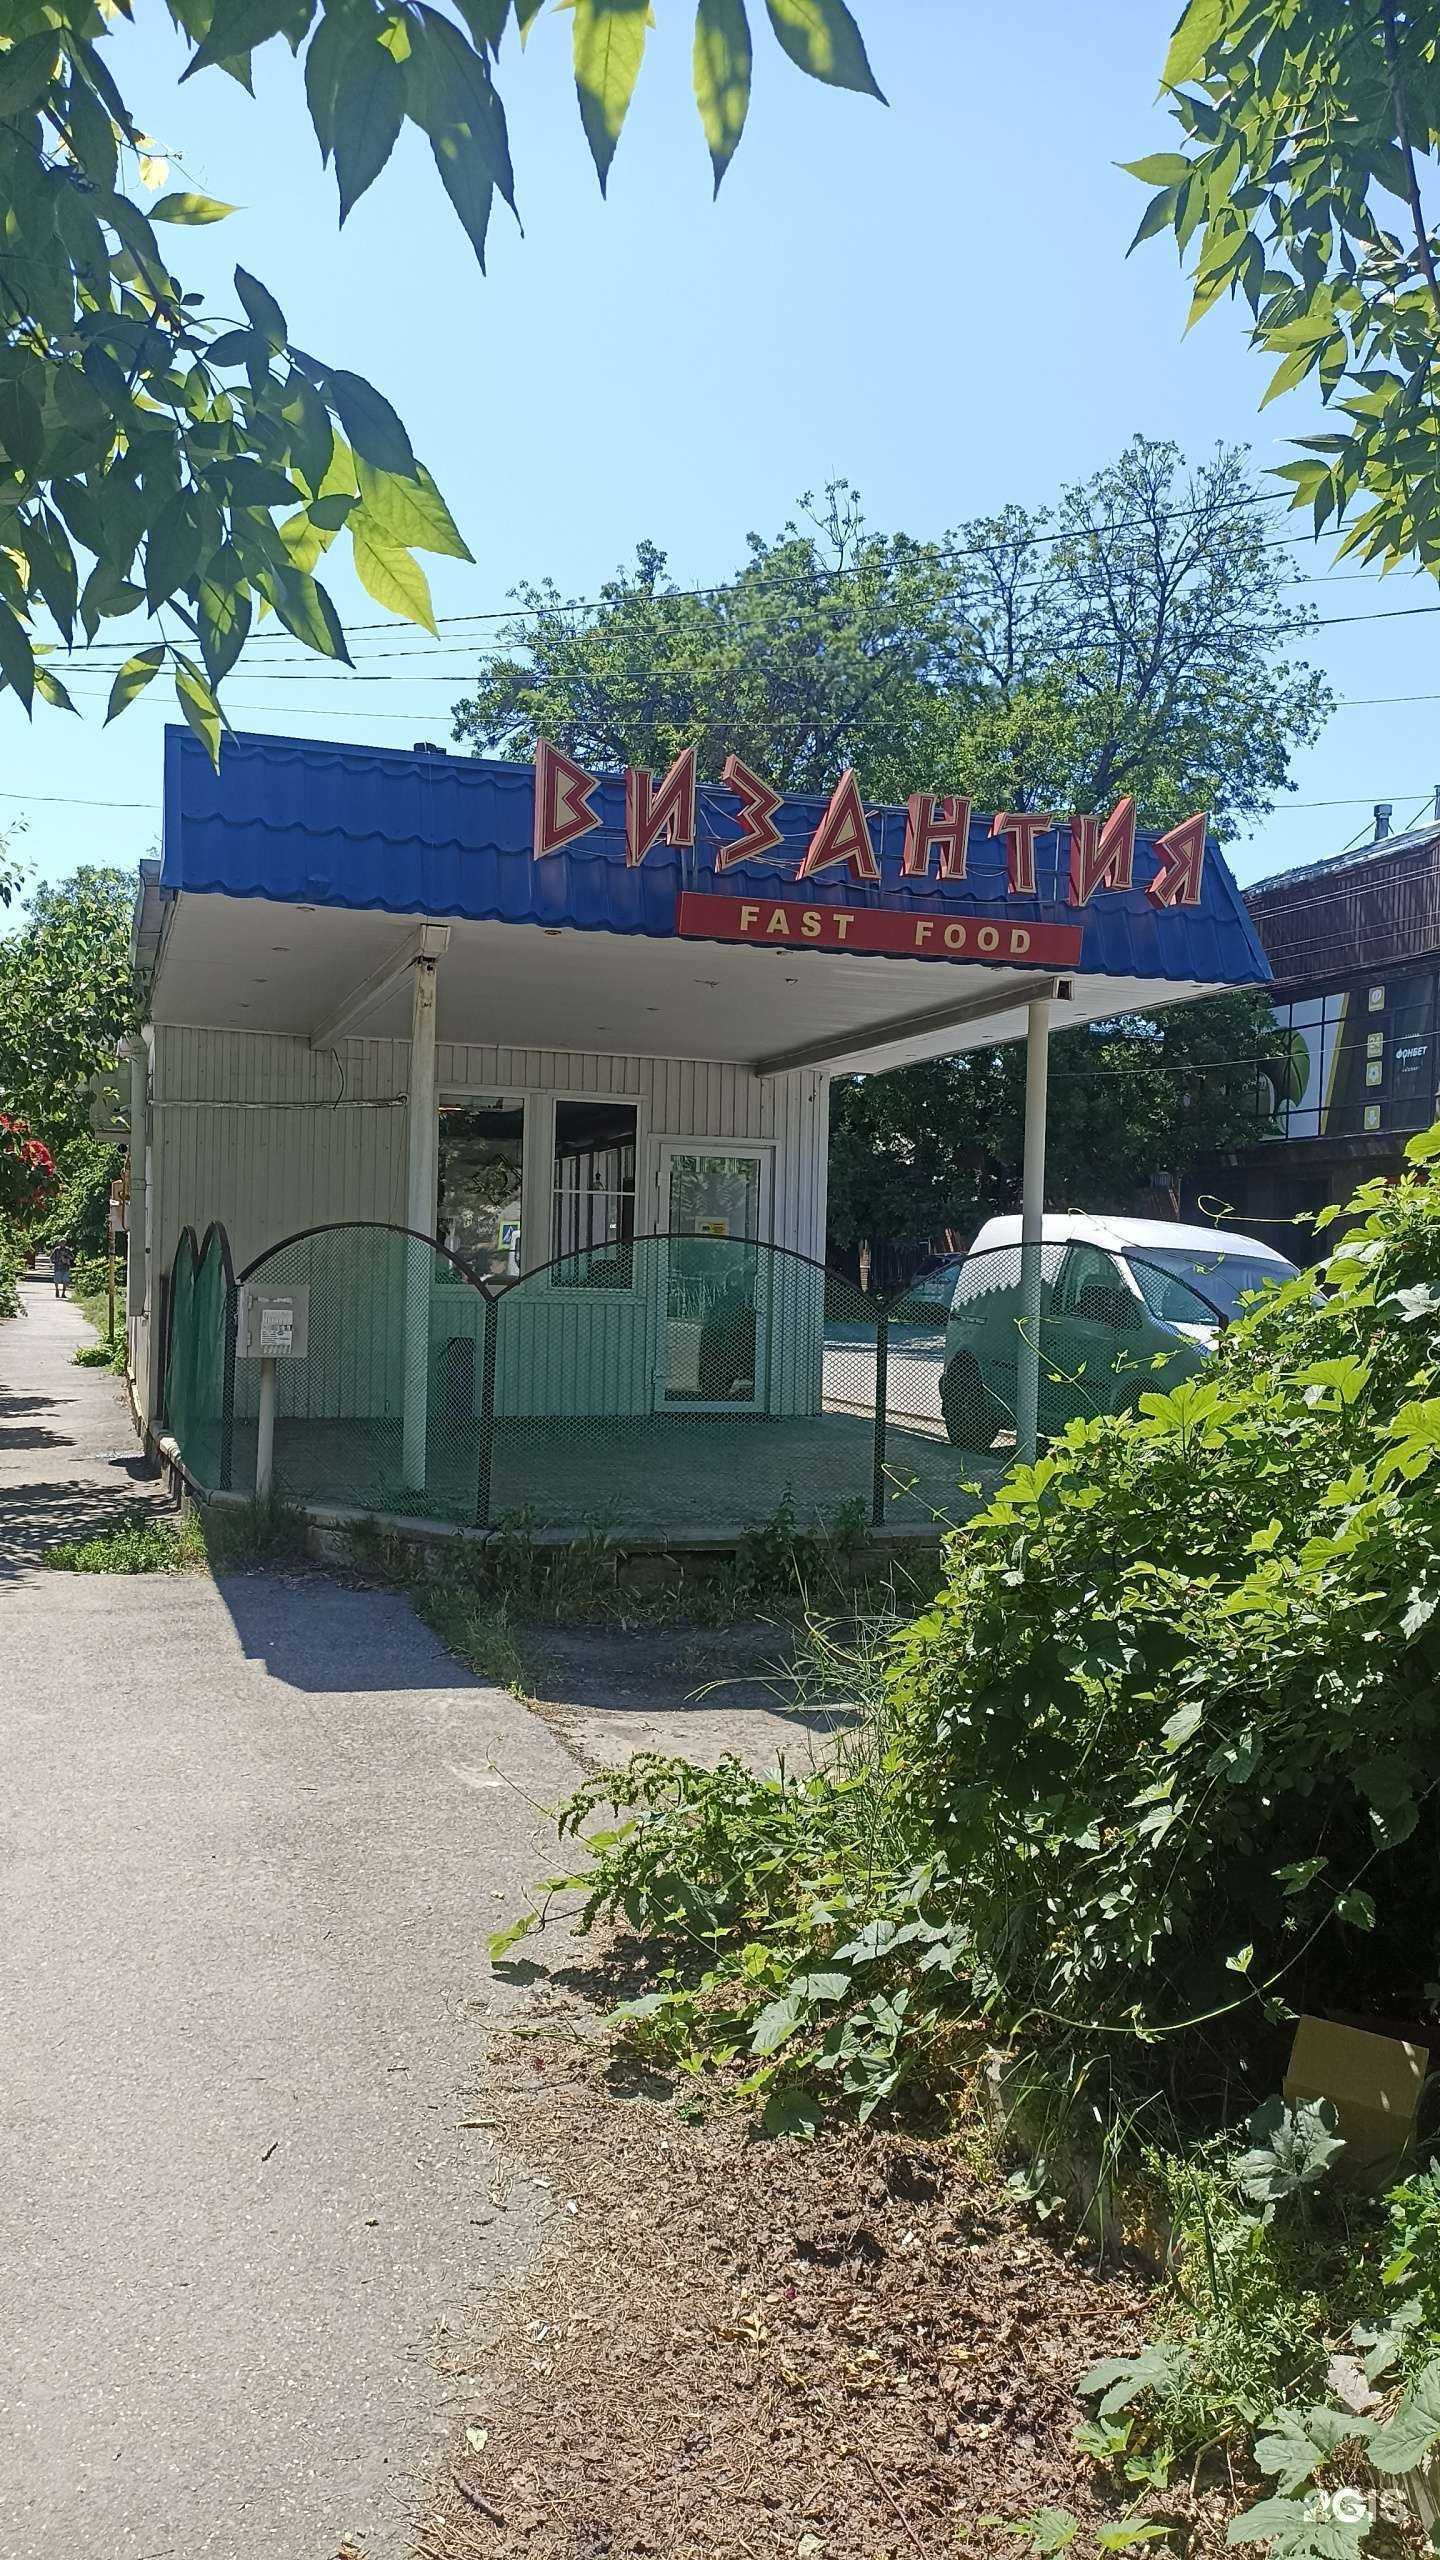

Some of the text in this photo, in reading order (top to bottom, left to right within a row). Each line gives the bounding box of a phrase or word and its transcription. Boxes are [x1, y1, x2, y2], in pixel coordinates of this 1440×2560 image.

[534, 736, 1209, 907] ВИЗАНТИЯ
[739, 904, 1032, 954] FAST FOOD
